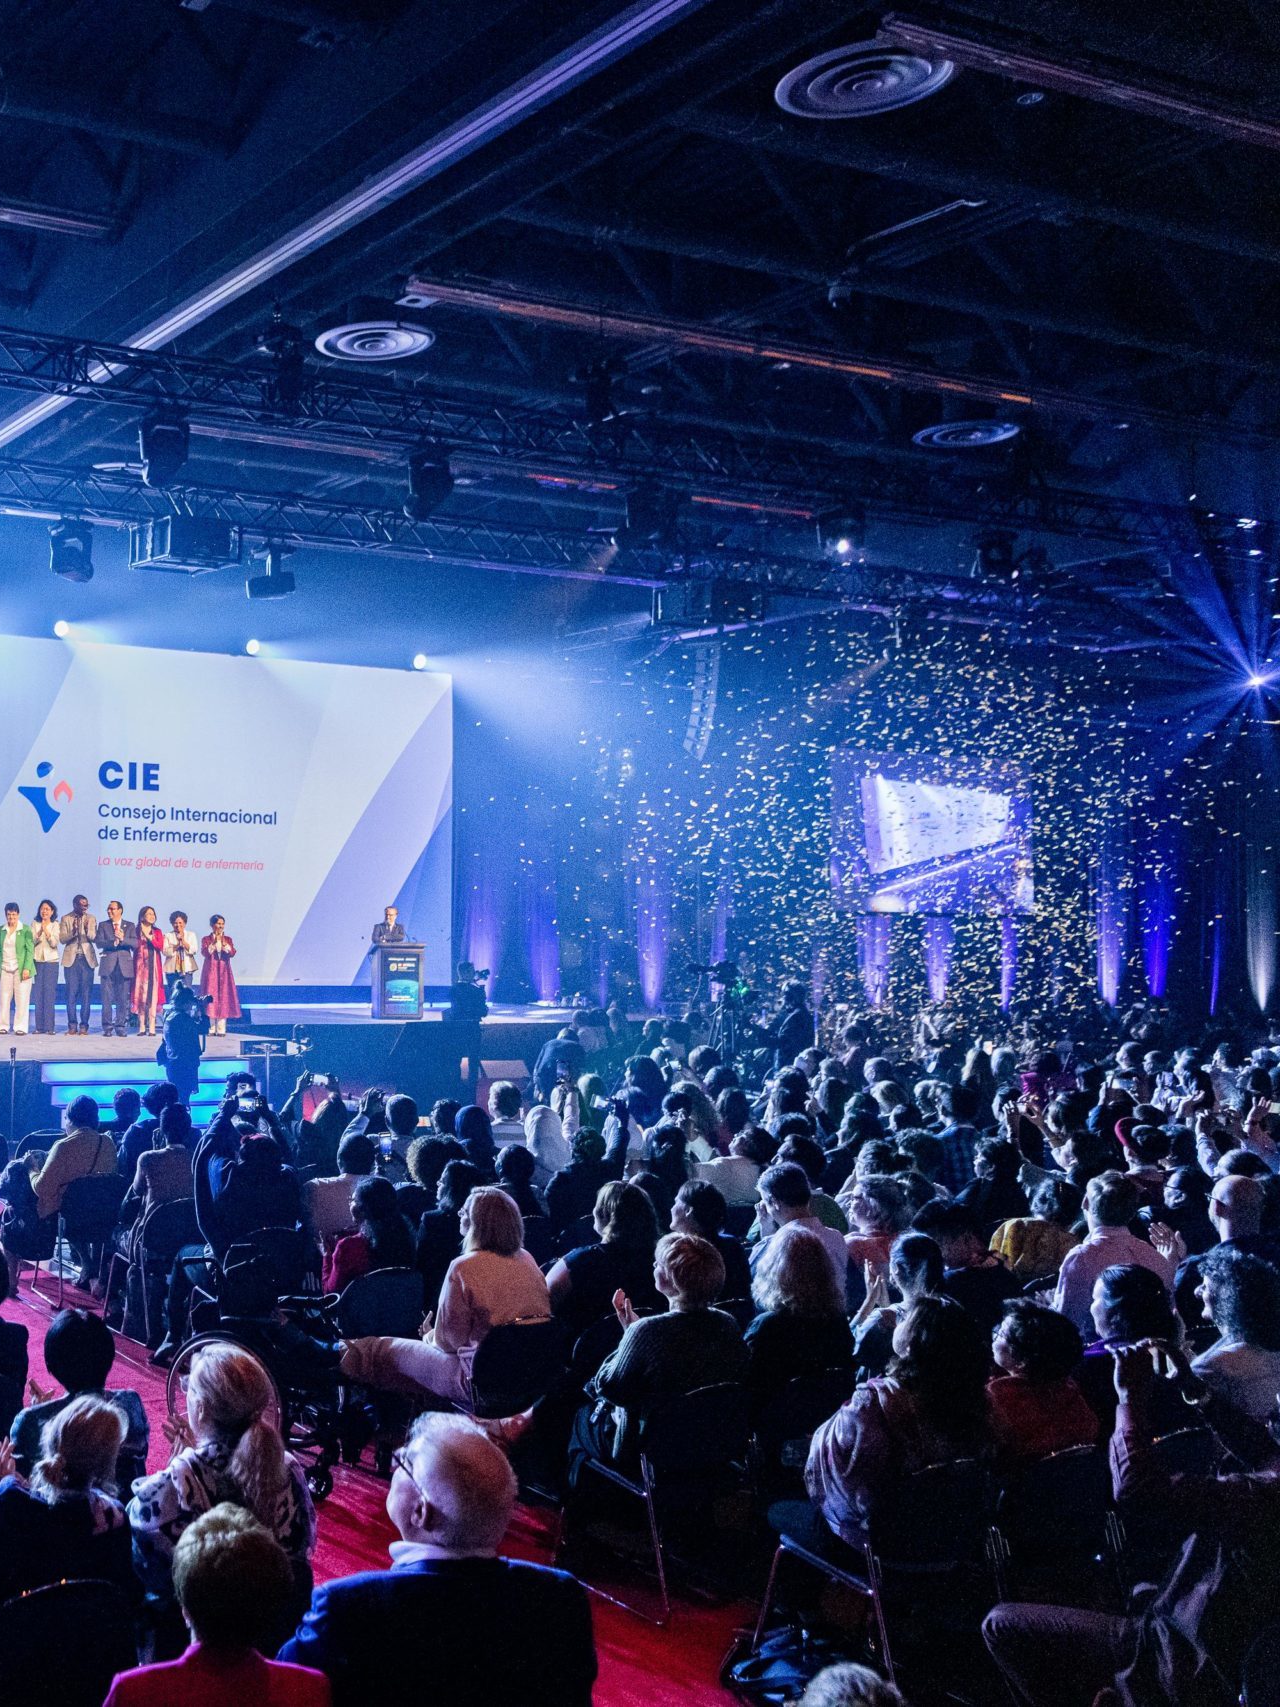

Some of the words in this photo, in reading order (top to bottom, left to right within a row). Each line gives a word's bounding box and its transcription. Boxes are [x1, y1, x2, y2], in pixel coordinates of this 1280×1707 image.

[98, 761, 160, 792] CIE
[98, 803, 167, 824] Consejo
[170, 806, 277, 825] Internacional
[97, 825, 119, 841] de
[123, 826, 218, 844] Enfermeras
[97, 855, 111, 866] La
[114, 857, 133, 866] voz
[135, 856, 171, 870] global
[174, 857, 189, 868] de
[191, 858, 202, 868] la
